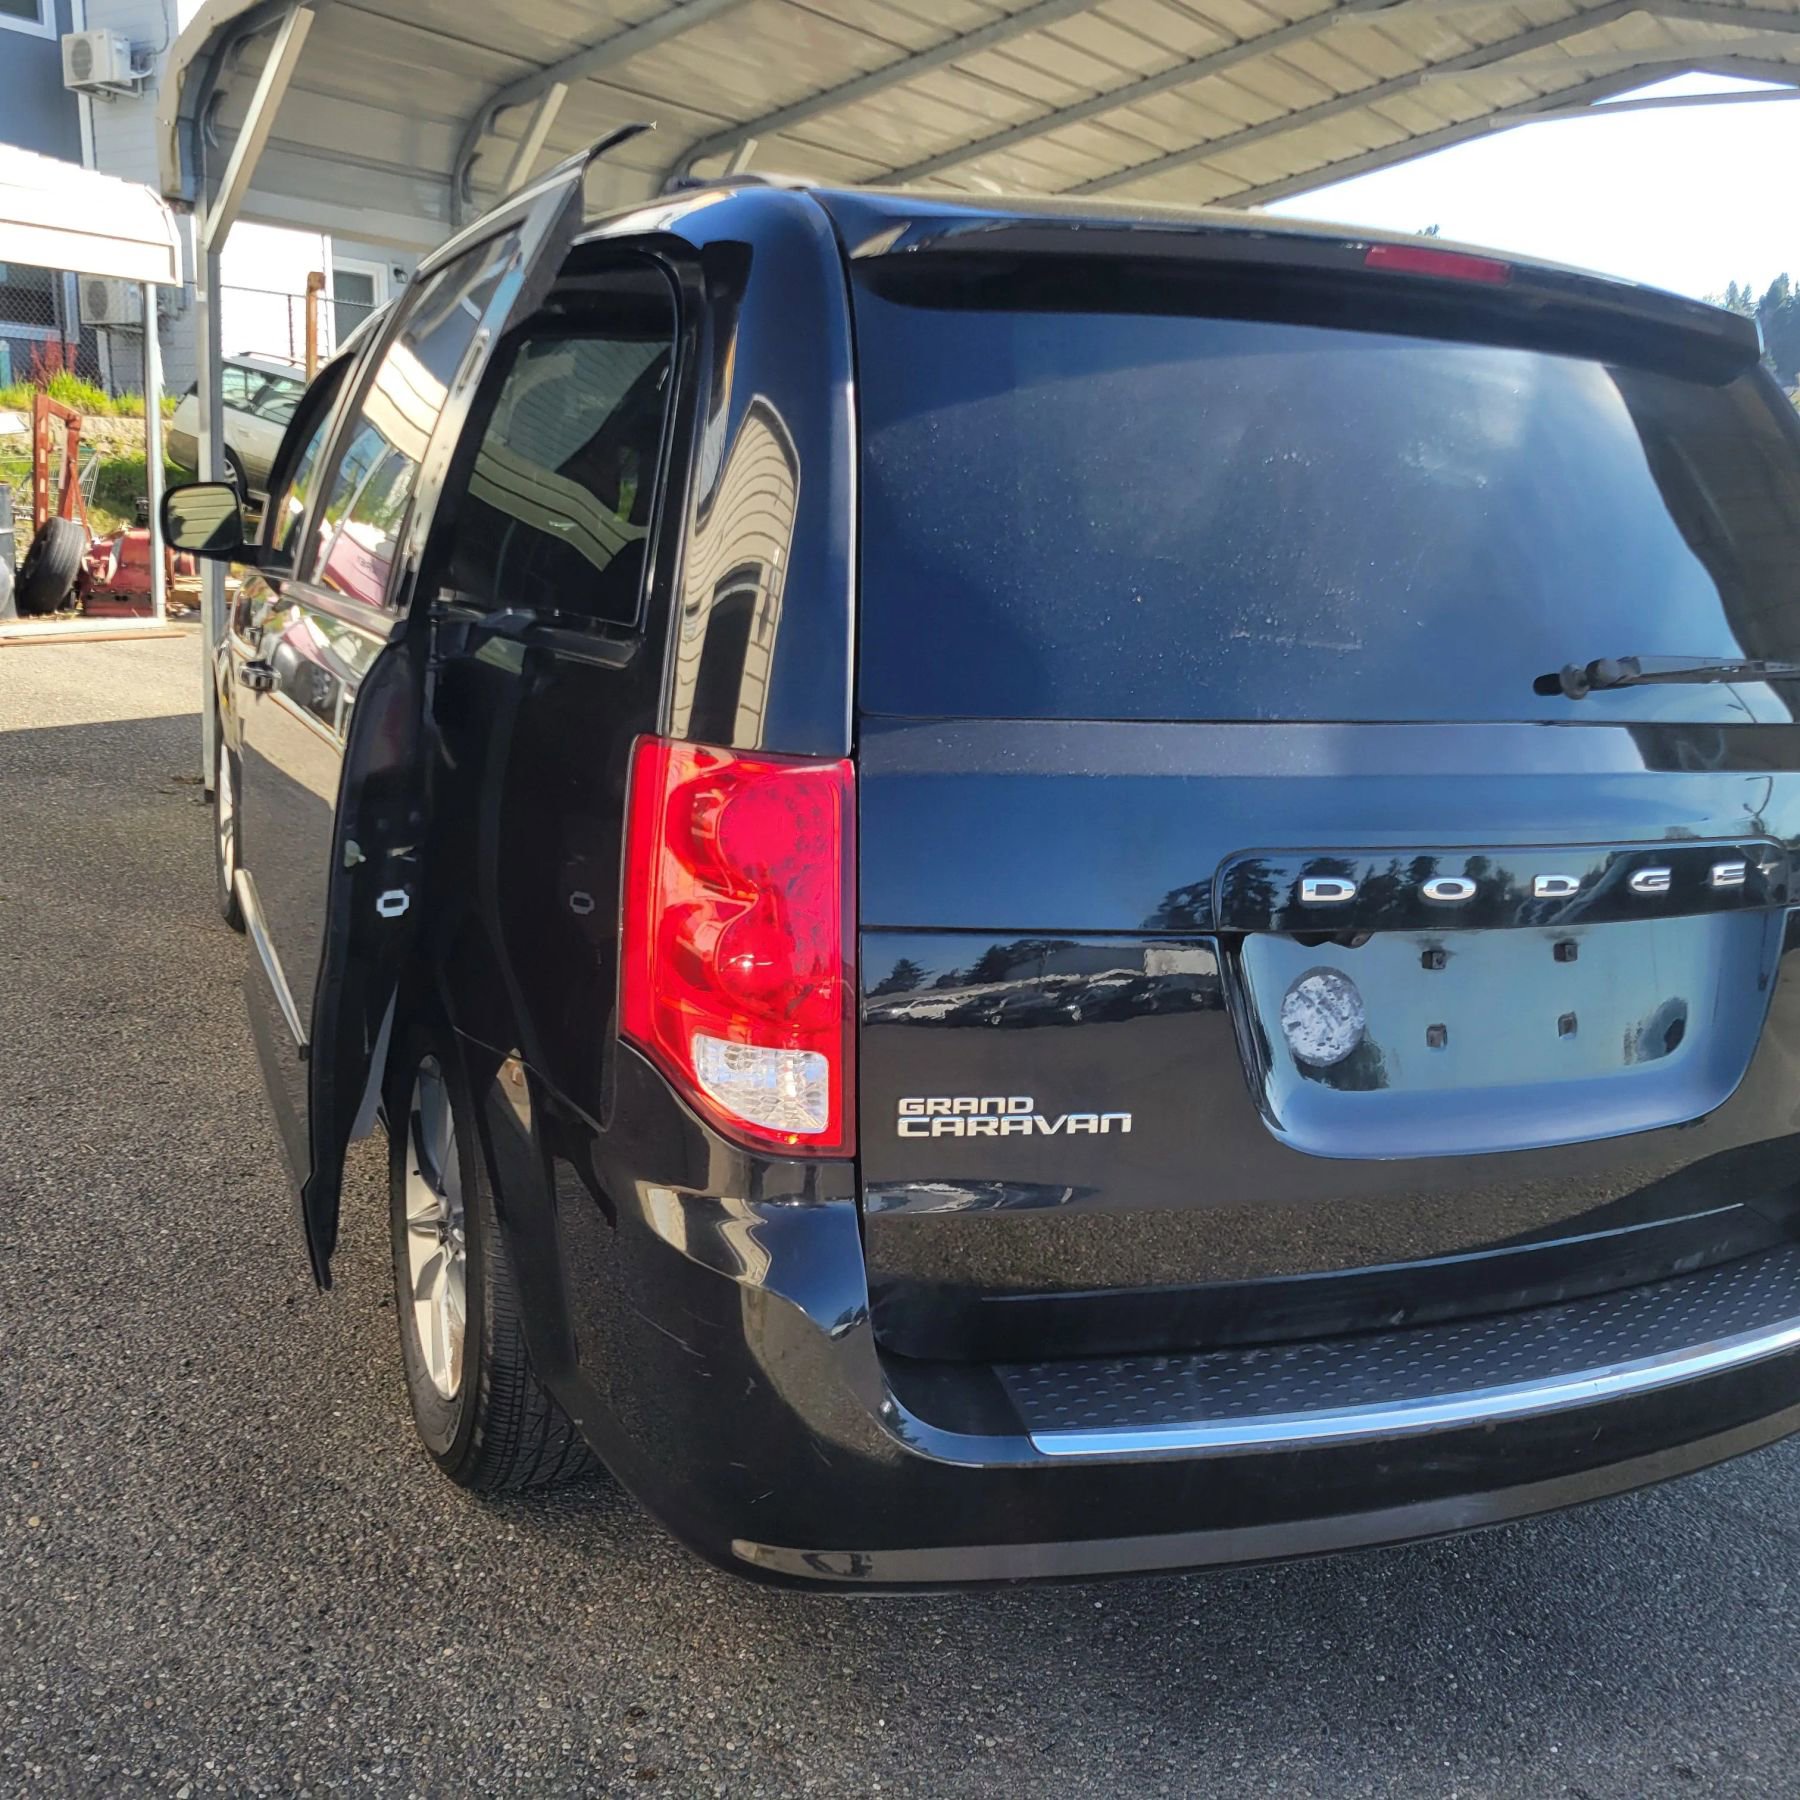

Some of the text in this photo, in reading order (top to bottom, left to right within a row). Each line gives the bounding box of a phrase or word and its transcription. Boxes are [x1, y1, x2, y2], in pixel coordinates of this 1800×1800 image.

[1301, 861, 1747, 902] DODGE
[897, 1096, 1035, 1115] GRAND
[897, 1113, 1132, 1138] CARAVAN
